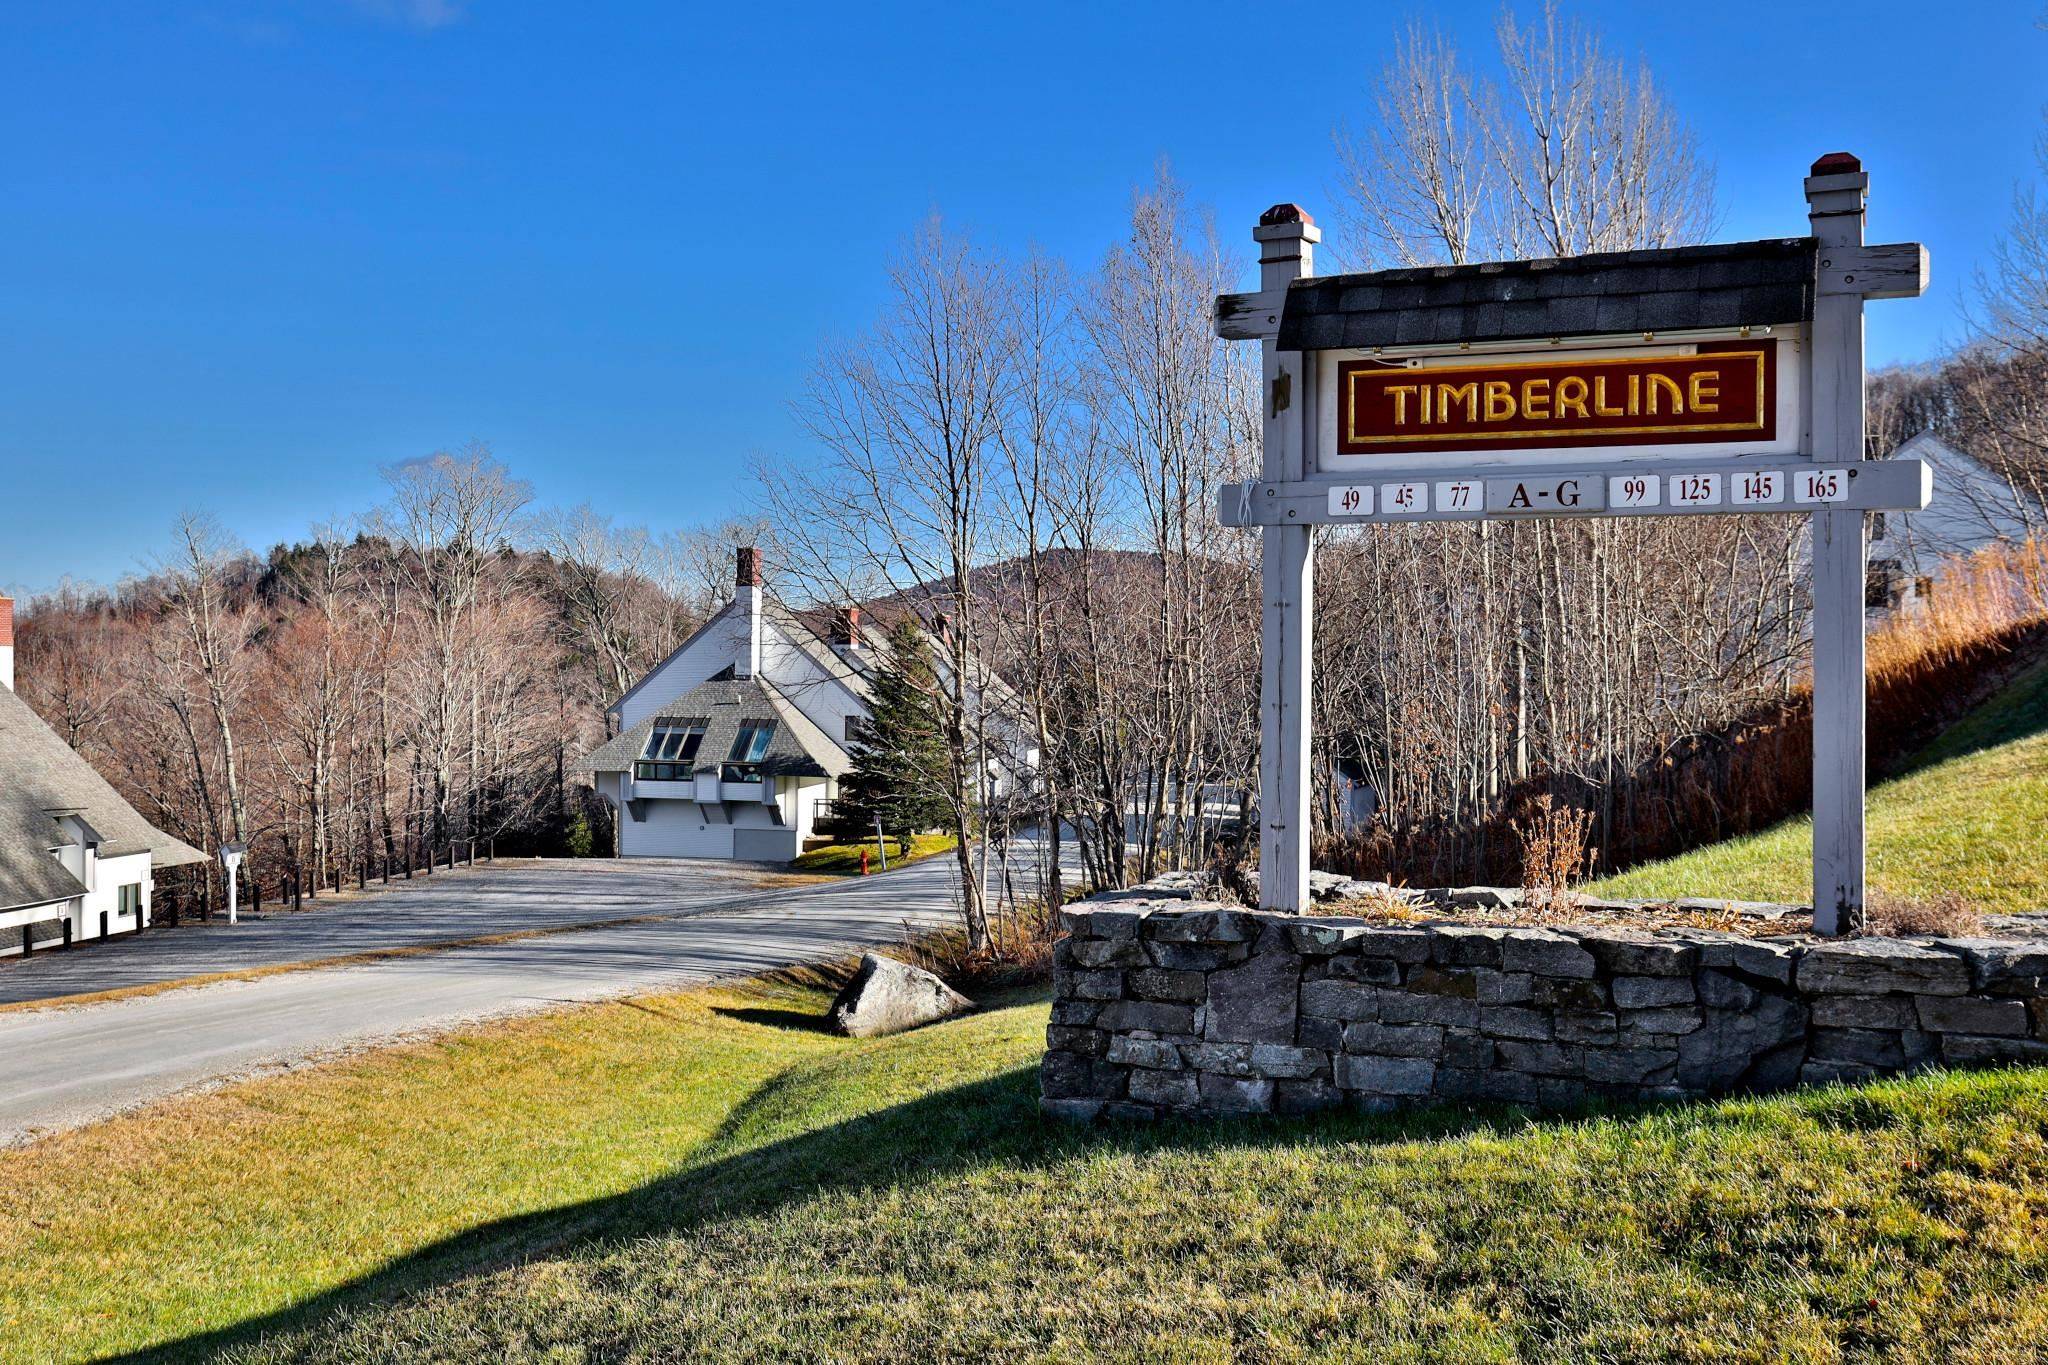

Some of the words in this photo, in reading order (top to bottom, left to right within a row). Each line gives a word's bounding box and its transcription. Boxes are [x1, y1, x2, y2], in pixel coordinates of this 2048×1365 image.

[1383, 371, 1720, 425] TIMBERLINE
[1341, 490, 1360, 511] 49
[1395, 488, 1413, 508] 45
[1450, 486, 1470, 507] 77
[1624, 480, 1646, 502] 99
[1680, 478, 1711, 500] 125
[1743, 477, 1772, 499] 145
[1807, 475, 1837, 498] 165
